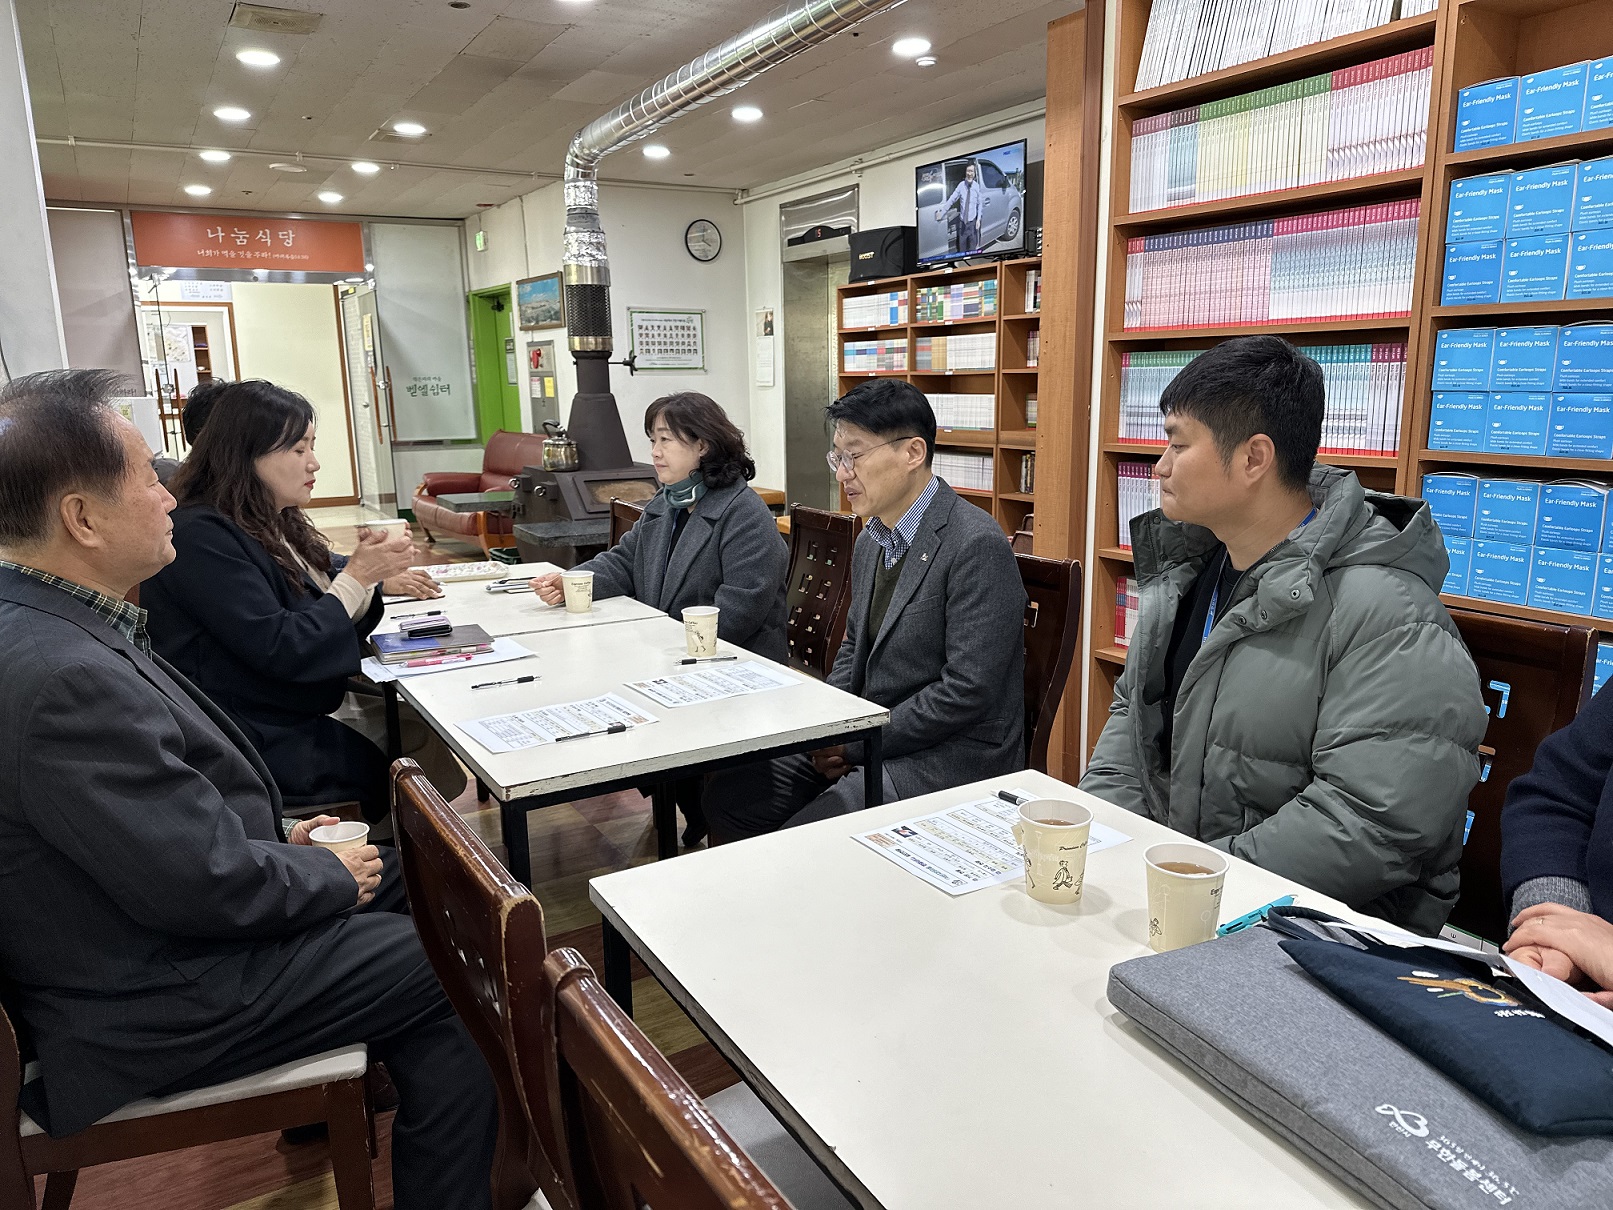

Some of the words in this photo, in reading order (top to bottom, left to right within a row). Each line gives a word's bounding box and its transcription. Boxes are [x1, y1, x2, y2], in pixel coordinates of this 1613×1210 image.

[1525, 83, 1561, 95] Ear-Friendly
[1562, 78, 1579, 88] Mask
[1462, 96, 1495, 107] Ear-Friendly
[1495, 91, 1511, 101] Mask
[1583, 172, 1613, 182] Ear-Frien
[1515, 182, 1551, 191] Ear-Friendly
[1551, 178, 1568, 187] Mask
[1455, 189, 1487, 198] Ear-Friendly
[221, 249, 236, 258] 먹을
[1509, 249, 1544, 257] Ear-Friendly
[1448, 254, 1480, 262] Ear-Friendly
[1499, 340, 1533, 348] Ear-Friendly
[1493, 404, 1527, 412] Ear-Friendly
[1556, 405, 1592, 414] Ear-Friendly
[1425, 487, 1455, 496] Ear-Friendly
[1483, 492, 1515, 501] Ear-Friendly
[1544, 497, 1579, 508] Ear-Friendly
[1477, 551, 1509, 562] Ear-Friendly
[1537, 559, 1572, 570] Ear-Friendly
[1573, 563, 1590, 571] Mask
[1425, 1139, 1513, 1205] 무한돌봄센터
